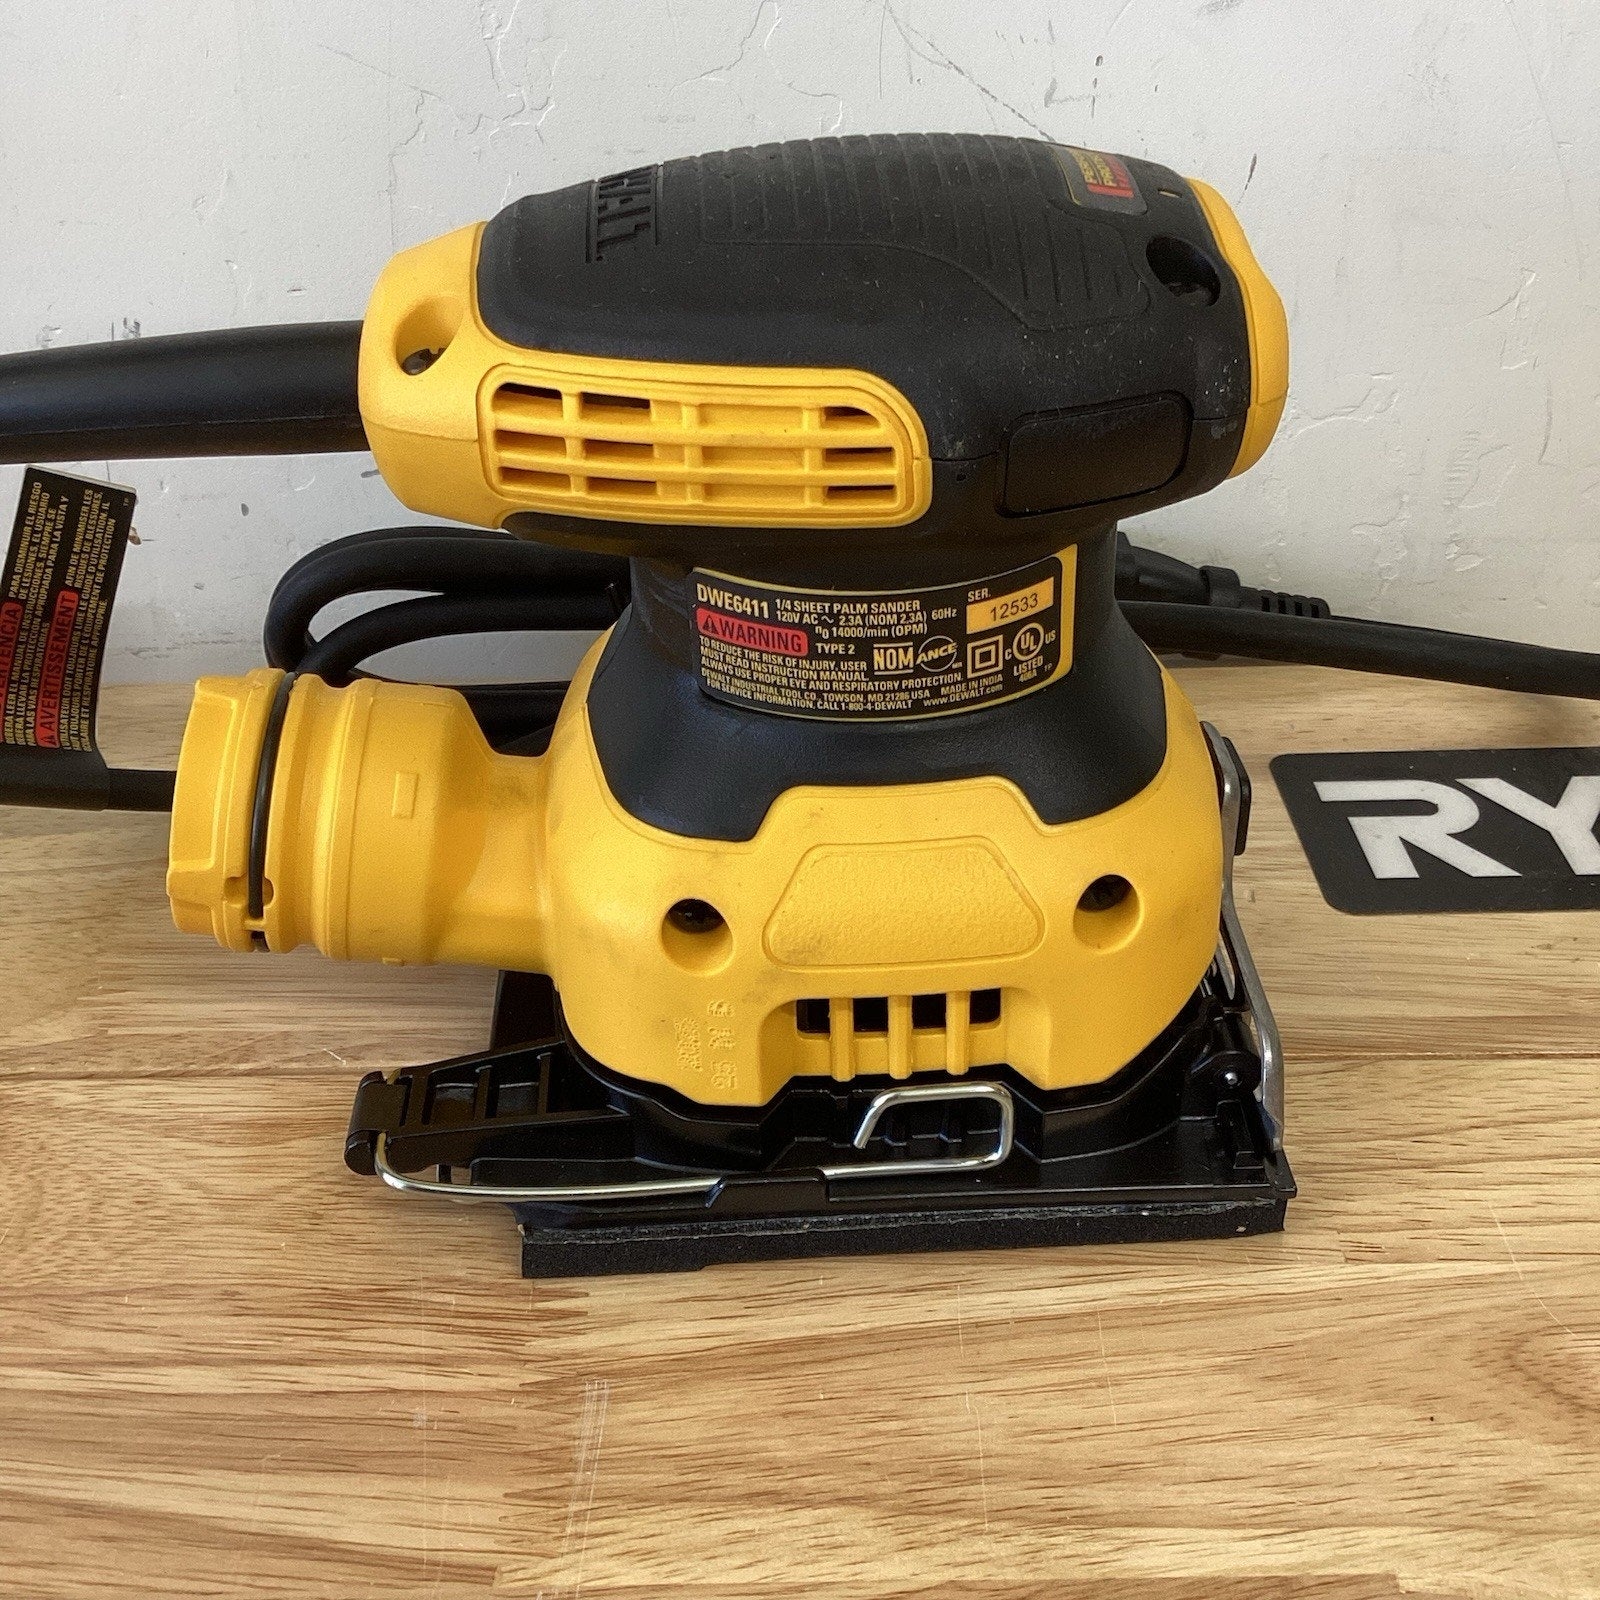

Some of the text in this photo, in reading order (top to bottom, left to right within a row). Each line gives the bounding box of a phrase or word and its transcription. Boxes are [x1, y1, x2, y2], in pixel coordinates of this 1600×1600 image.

[34, 493, 50, 531] USUARIO
[47, 508, 56, 520] SE
[55, 505, 68, 529] VISTA
[101, 502, 110, 510] IL
[8, 482, 42, 598] PARA DISMINUIR EL RIESGO
[31, 533, 41, 543] EL
[38, 521, 54, 558] SIEMPRE
[52, 531, 62, 541] LA
[65, 489, 93, 587] AFIN DE MINIMISER LES
[98, 518, 116, 570] PROTECTION
[46, 543, 59, 567] PARA
[74, 553, 89, 588] RISQUES
[82, 540, 92, 552] DE
[81, 573, 94, 600] GUIDE
[95, 571, 105, 583] DE
[18, 588, 28, 600] DE
[34, 568, 53, 617] APROPIADA
[697, 583, 769, 619] DWE6411
[967, 588, 992, 602] SER.
[79, 600, 88, 611] LE
[775, 598, 921, 614] 1/4 SHEET PALM SANDER
[776, 607, 958, 626] 120V AC 2.3A (NOM 2.3A) 60Hz
[990, 593, 1039, 621] 12533
[75, 612, 86, 630] LIRE
[832, 626, 889, 638] 14000/min
[891, 622, 928, 638] (OPM)
[19, 631, 28, 642] DE
[719, 618, 802, 653] WARNING
[1020, 632, 1038, 652] UL
[1045, 629, 1056, 644] US
[65, 631, 80, 674] TOUJOURS
[78, 645, 88, 657] DE
[699, 634, 711, 648] TO
[711, 639, 742, 656] REDUCE
[743, 649, 760, 661] THE
[762, 653, 784, 666] RISK
[785, 657, 797, 668] OF
[841, 660, 867, 671] USER
[816, 643, 856, 655] TYPE 2
[873, 646, 915, 671] NOM
[915, 641, 958, 665] ANCE
[11, 645, 25, 680] MANUAL
[40, 594, 76, 731] AVERTISSEMENT
[73, 658, 86, 690] PORTER
[700, 645, 870, 681] MUST READ INSTRUCTION MANUAL.
[701, 656, 963, 692] ALWAYS USE PROPER EYE AND RESPIRATORY PROTECTION.
[1013, 655, 1044, 676] LISTED
[9, 683, 18, 692] EL
[21, 672, 30, 684] LA
[81, 649, 97, 706] RESPIRATOIRE
[701, 667, 730, 684] DEWALT
[731, 676, 780, 696] INDUSTRIAL
[781, 687, 802, 699] TOOL
[867, 691, 884, 702] MD
[911, 688, 931, 700] USA
[940, 673, 1003, 696] MADE IN INDIA
[6, 693, 17, 714] LEER
[16, 685, 28, 716] LLEVAR
[707, 678, 721, 690] FOR
[721, 682, 752, 698] SERVICE
[817, 701, 840, 711] CALL
[840, 699, 914, 711] 1-800-4-DEWALT
[923, 683, 1004, 707] www.DEWALT.com
[25, 710, 36, 727] LAS
[70, 691, 81, 734] TOUJOURS
[81, 707, 90, 718] ET
